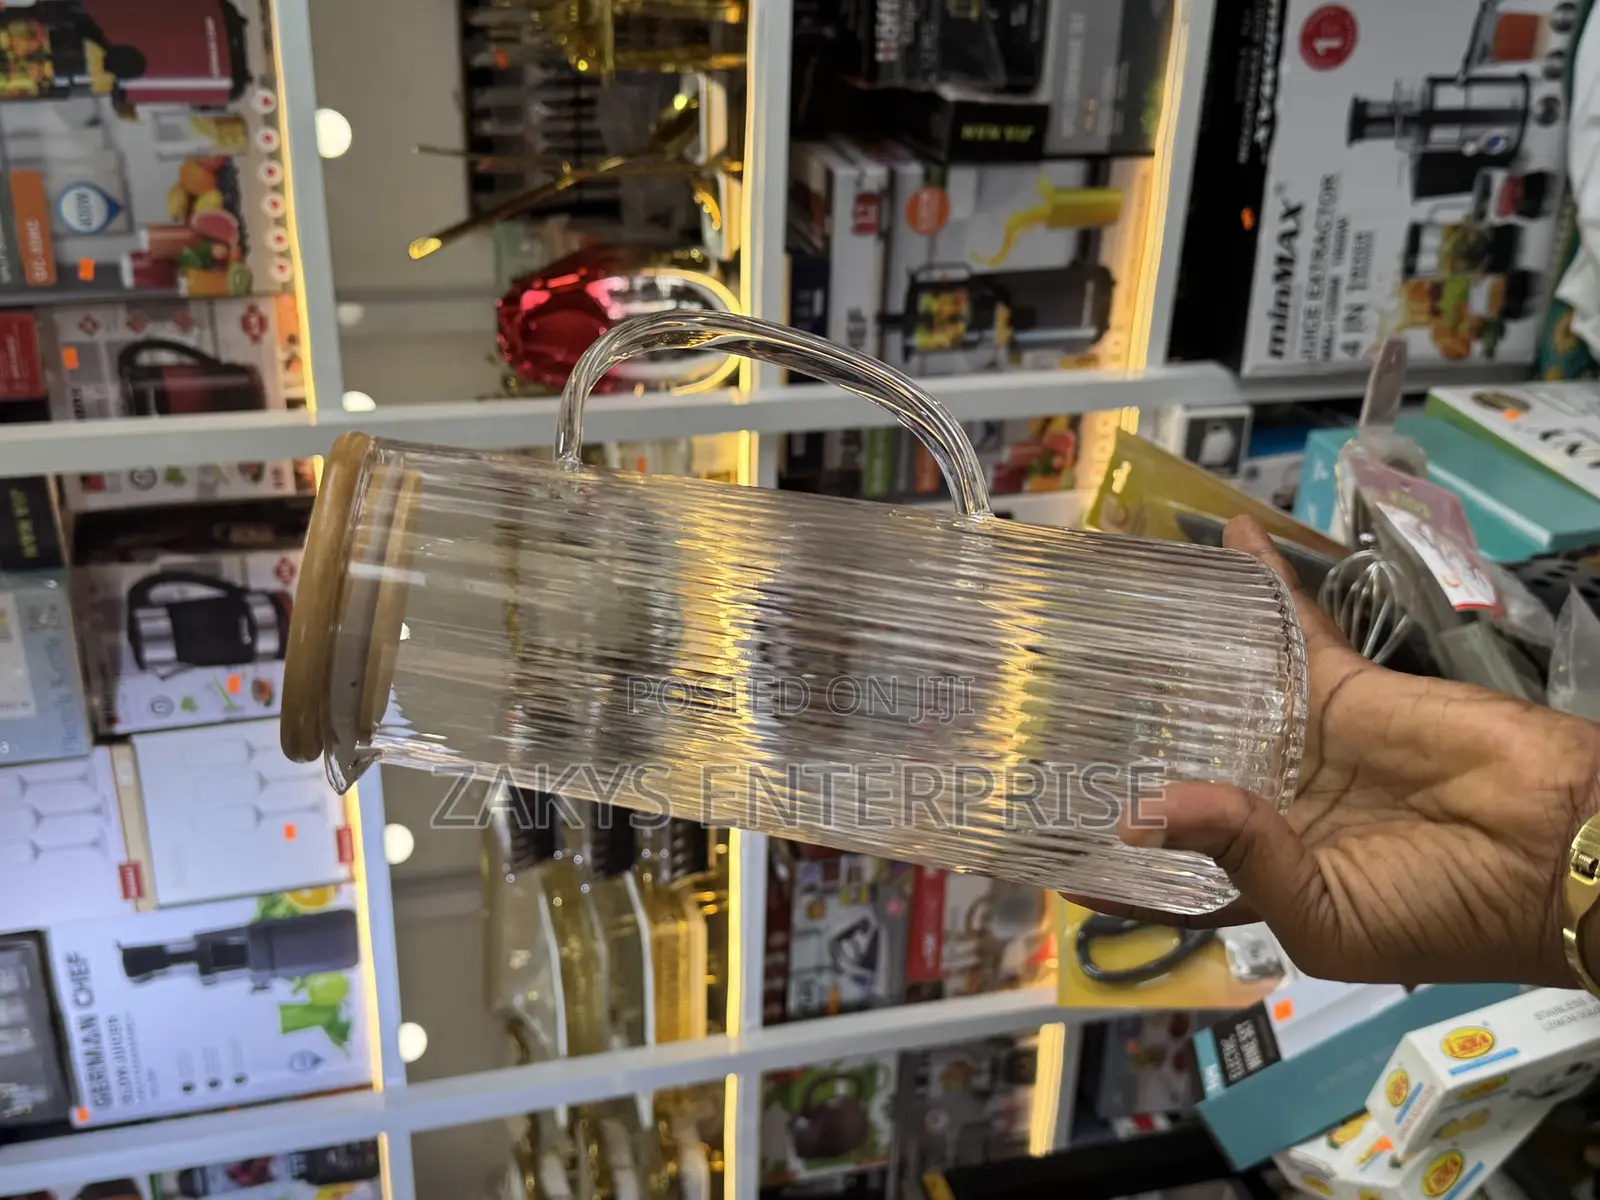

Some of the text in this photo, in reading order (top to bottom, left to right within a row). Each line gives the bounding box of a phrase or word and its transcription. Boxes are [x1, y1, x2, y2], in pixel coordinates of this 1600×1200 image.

[1312, 35, 1344, 55] 1
[1267, 199, 1303, 359] minMAX
[65, 952, 112, 1108] GERMAN CHEF
